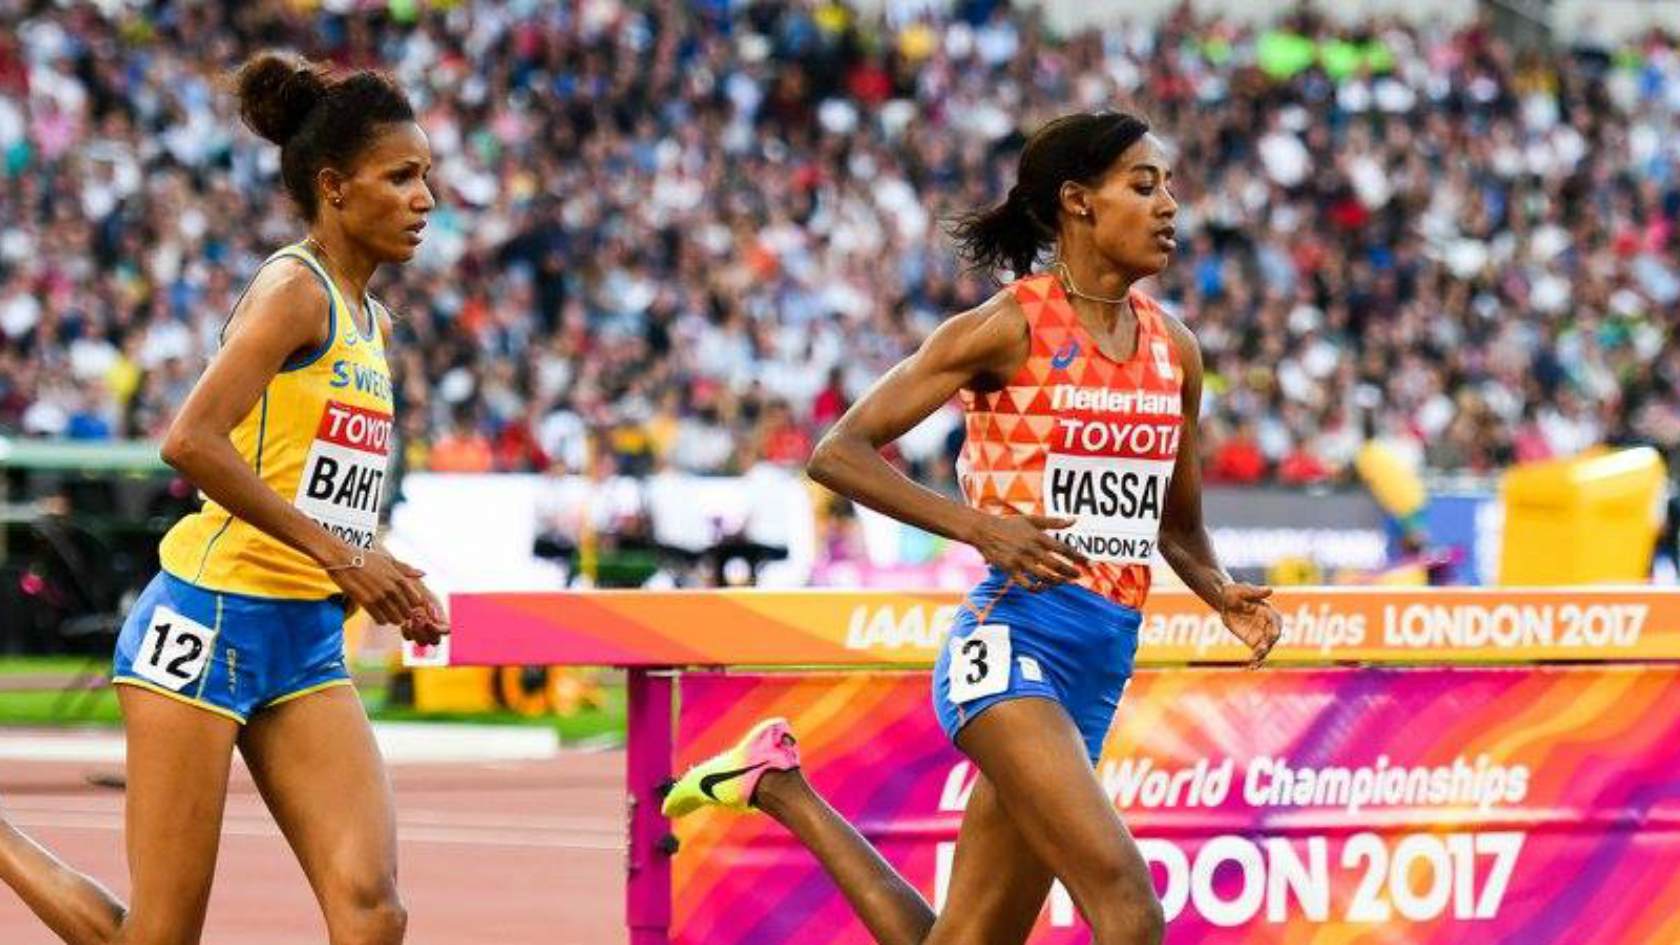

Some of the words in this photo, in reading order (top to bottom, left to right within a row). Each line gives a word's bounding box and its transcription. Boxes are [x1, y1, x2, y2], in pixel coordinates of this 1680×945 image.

[1052, 468, 1170, 520] HASSA
[1055, 532, 1136, 558] ONDON
[1138, 539, 1156, 558] 2
[150, 622, 203, 679] 12
[1385, 604, 1554, 648] LONDON
[1559, 604, 1649, 648] 2017
[962, 639, 989, 685] 3
[1100, 757, 1235, 808] World
[1243, 754, 1531, 816] Championships
[1340, 831, 1528, 923] 2017
